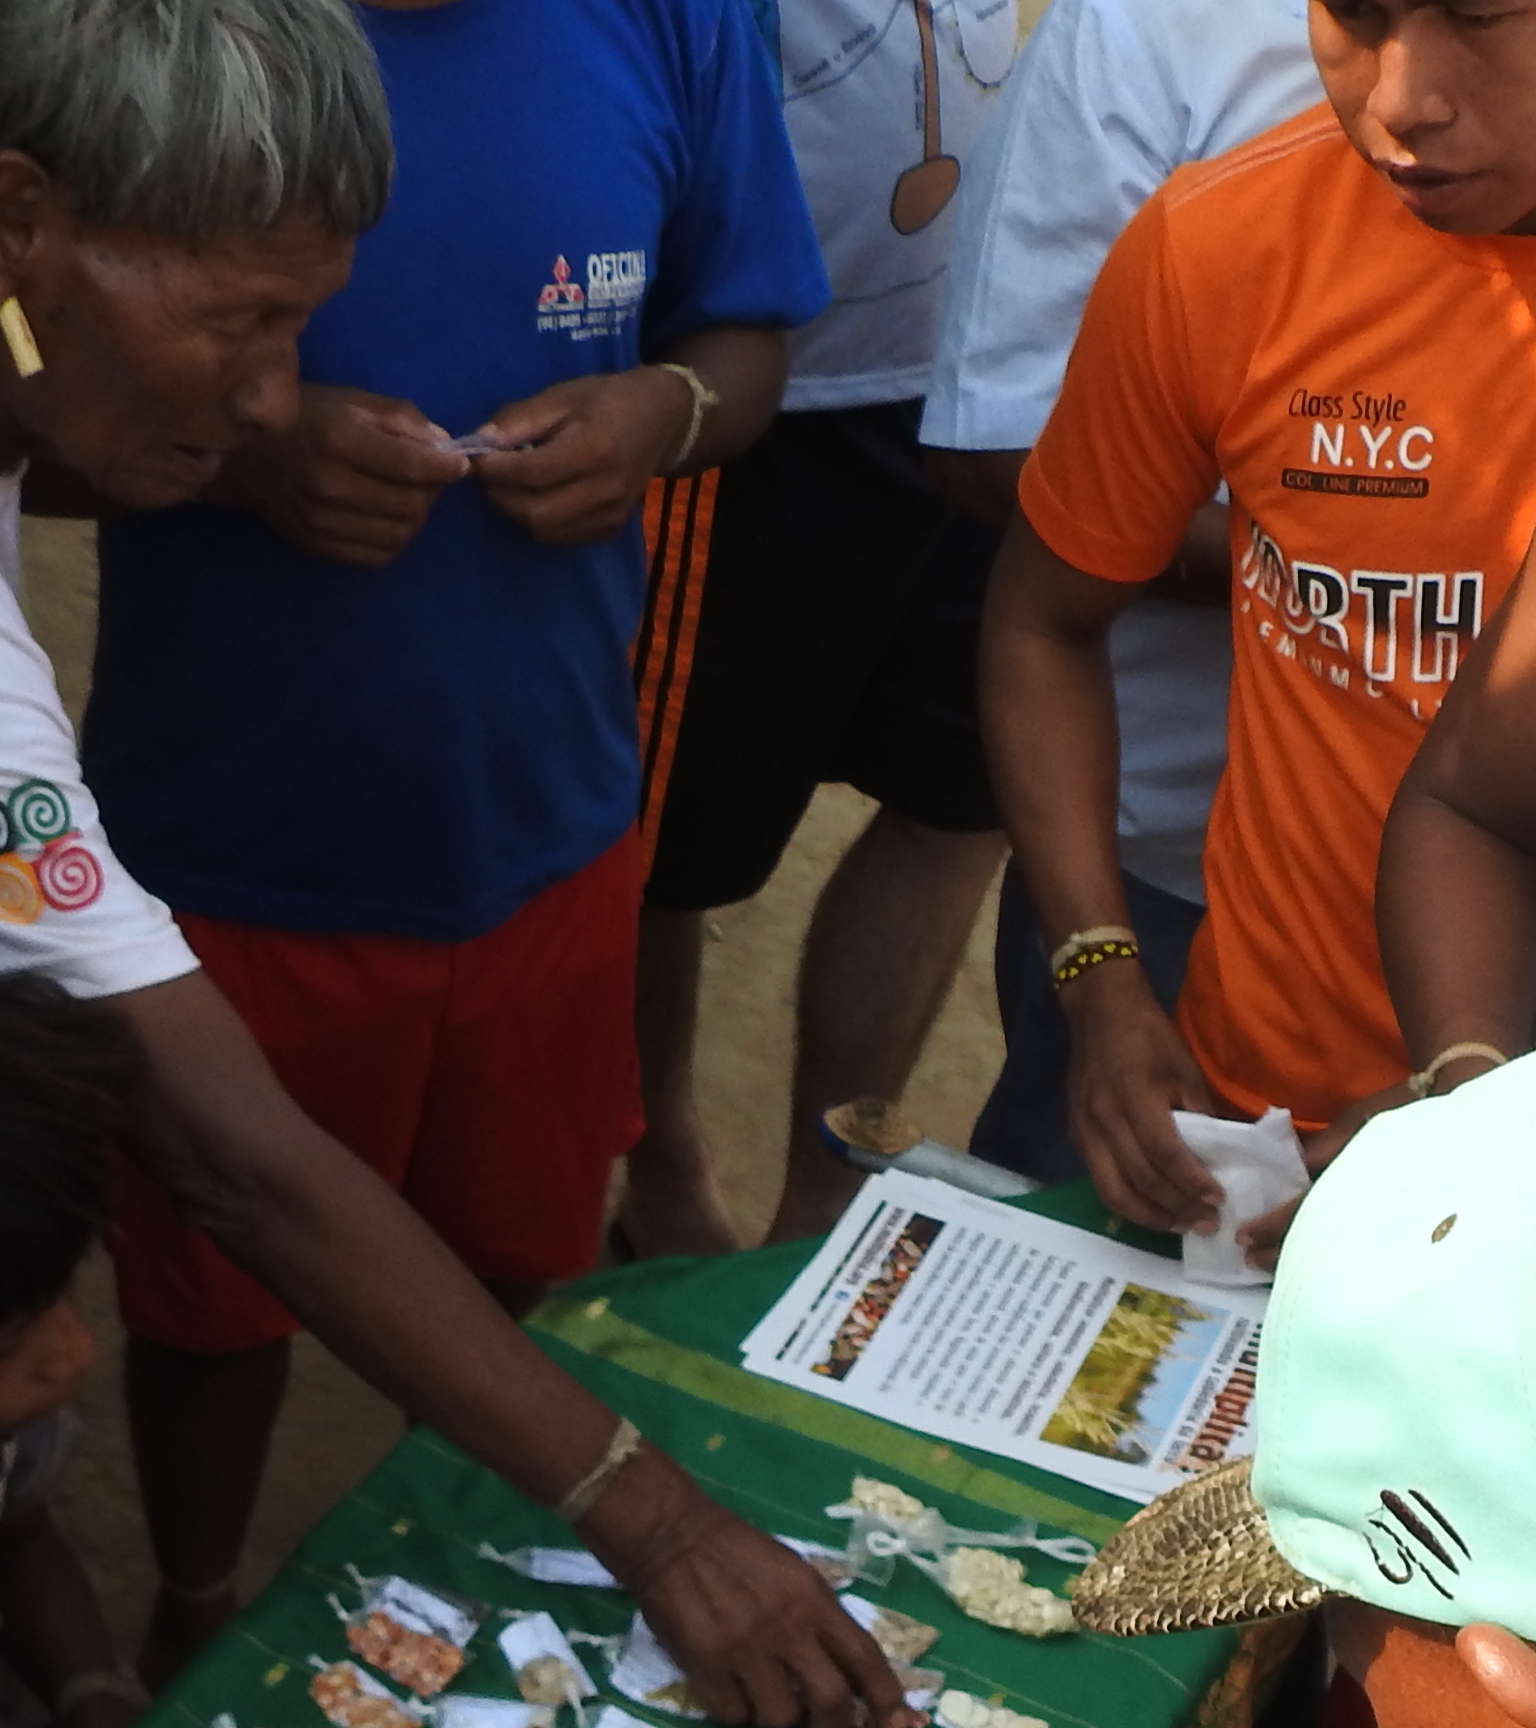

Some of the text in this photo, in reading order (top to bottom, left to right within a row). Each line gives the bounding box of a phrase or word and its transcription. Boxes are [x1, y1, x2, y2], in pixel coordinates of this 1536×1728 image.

[1287, 387, 1407, 428] Class Style
[1310, 420, 1435, 472] N.Y.C
[1356, 479, 1424, 495] PREMIUM
